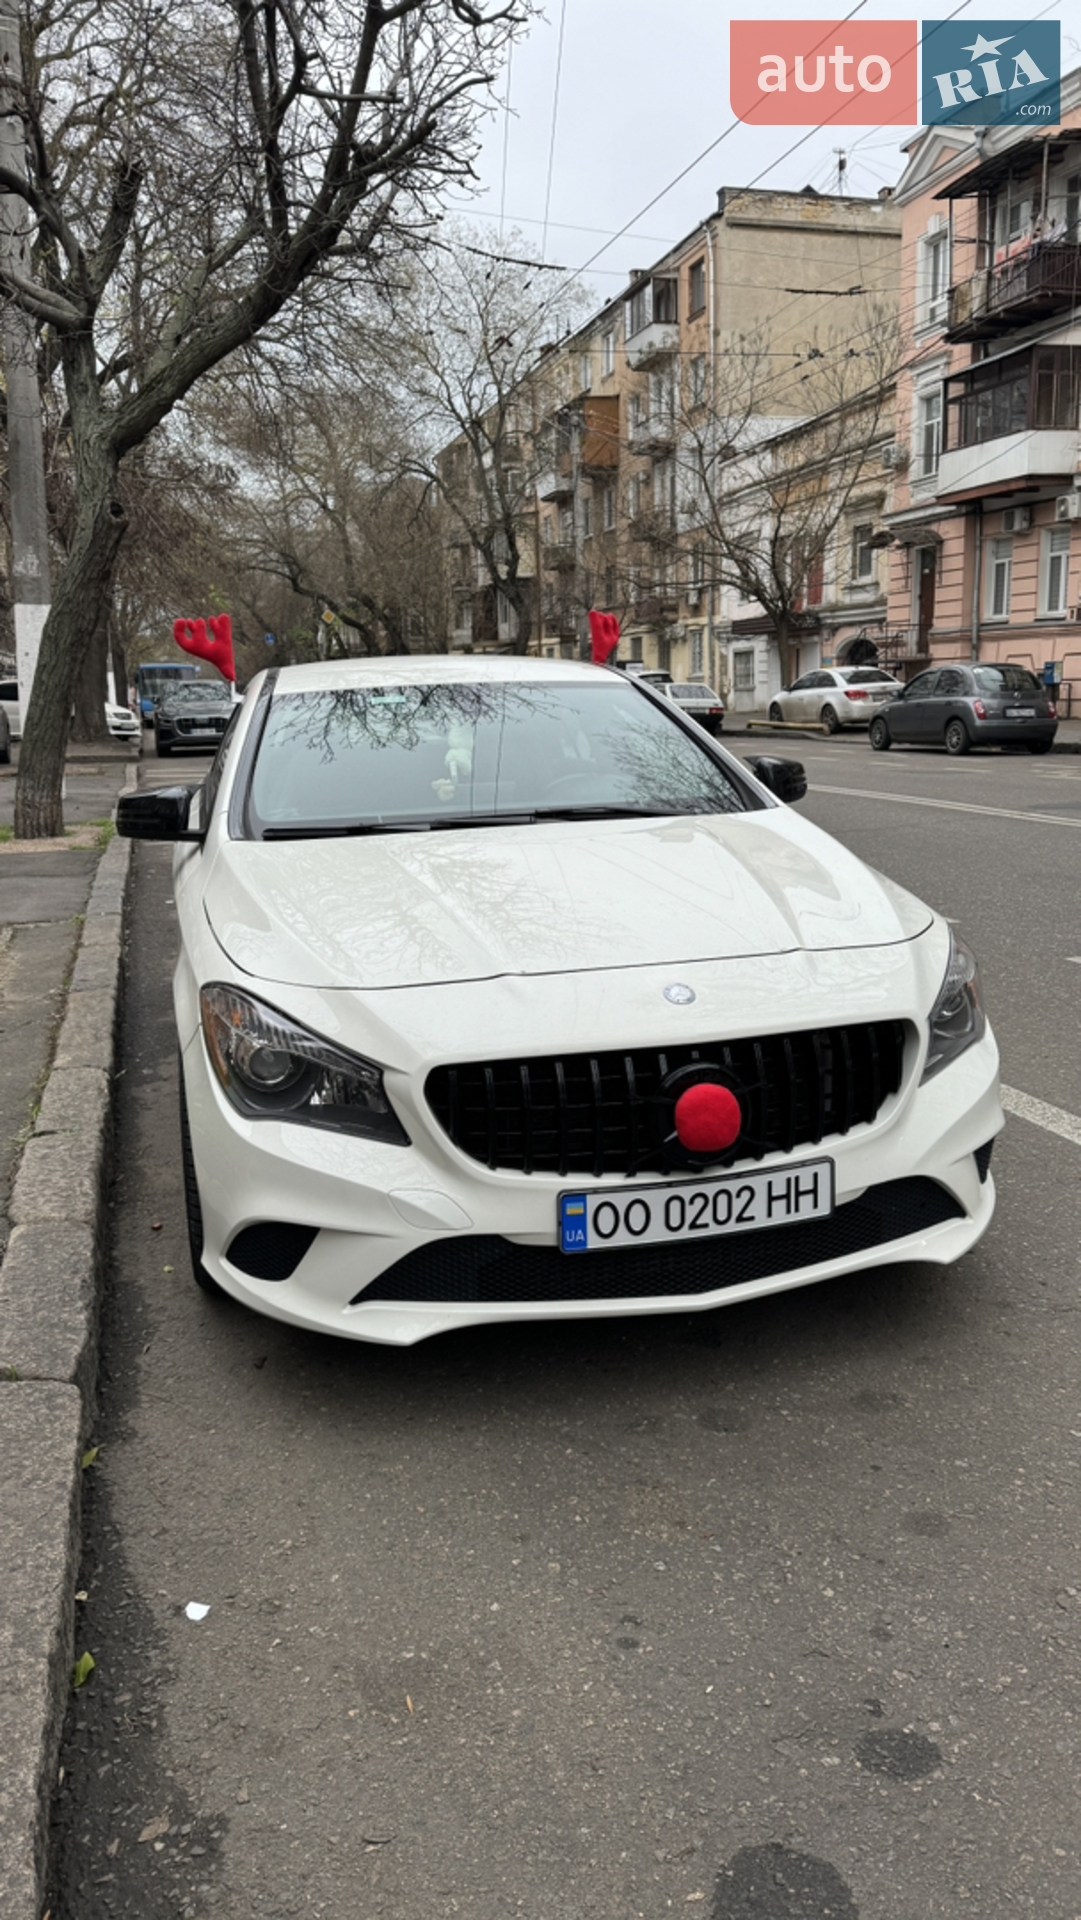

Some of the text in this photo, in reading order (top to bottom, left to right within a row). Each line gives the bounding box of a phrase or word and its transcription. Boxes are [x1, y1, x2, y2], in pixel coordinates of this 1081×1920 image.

[592, 1171, 819, 1239] OO 0202 HH
[566, 1230, 585, 1242] UA
